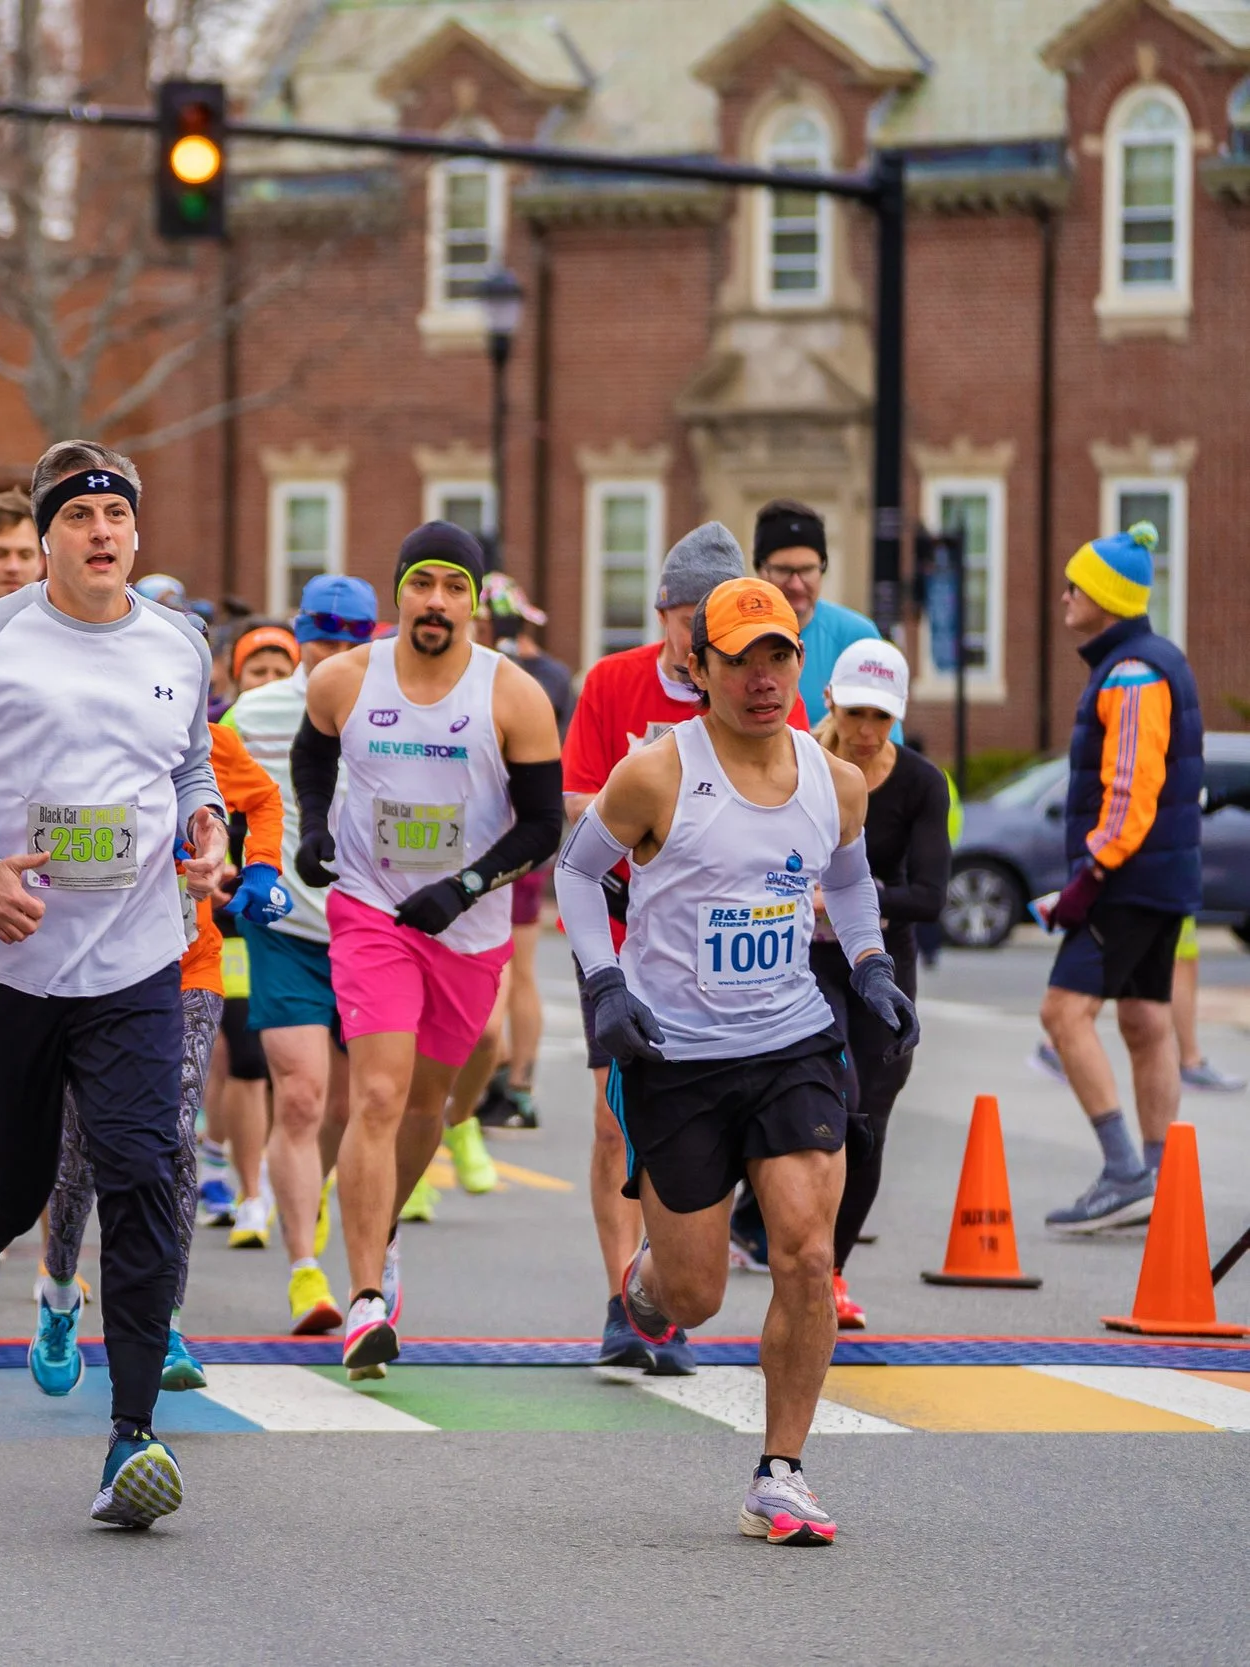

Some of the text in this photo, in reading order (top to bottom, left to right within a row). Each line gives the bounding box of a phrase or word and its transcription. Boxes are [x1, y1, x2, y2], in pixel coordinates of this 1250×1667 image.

[39, 806, 61, 824] Black
[64, 808, 77, 824] Cat
[95, 807, 126, 825] MILER
[50, 827, 114, 862] 258
[393, 820, 440, 849] 197
[708, 914, 796, 929] Fitness Programs
[710, 908, 751, 921] B&S
[704, 925, 796, 973] 1001
